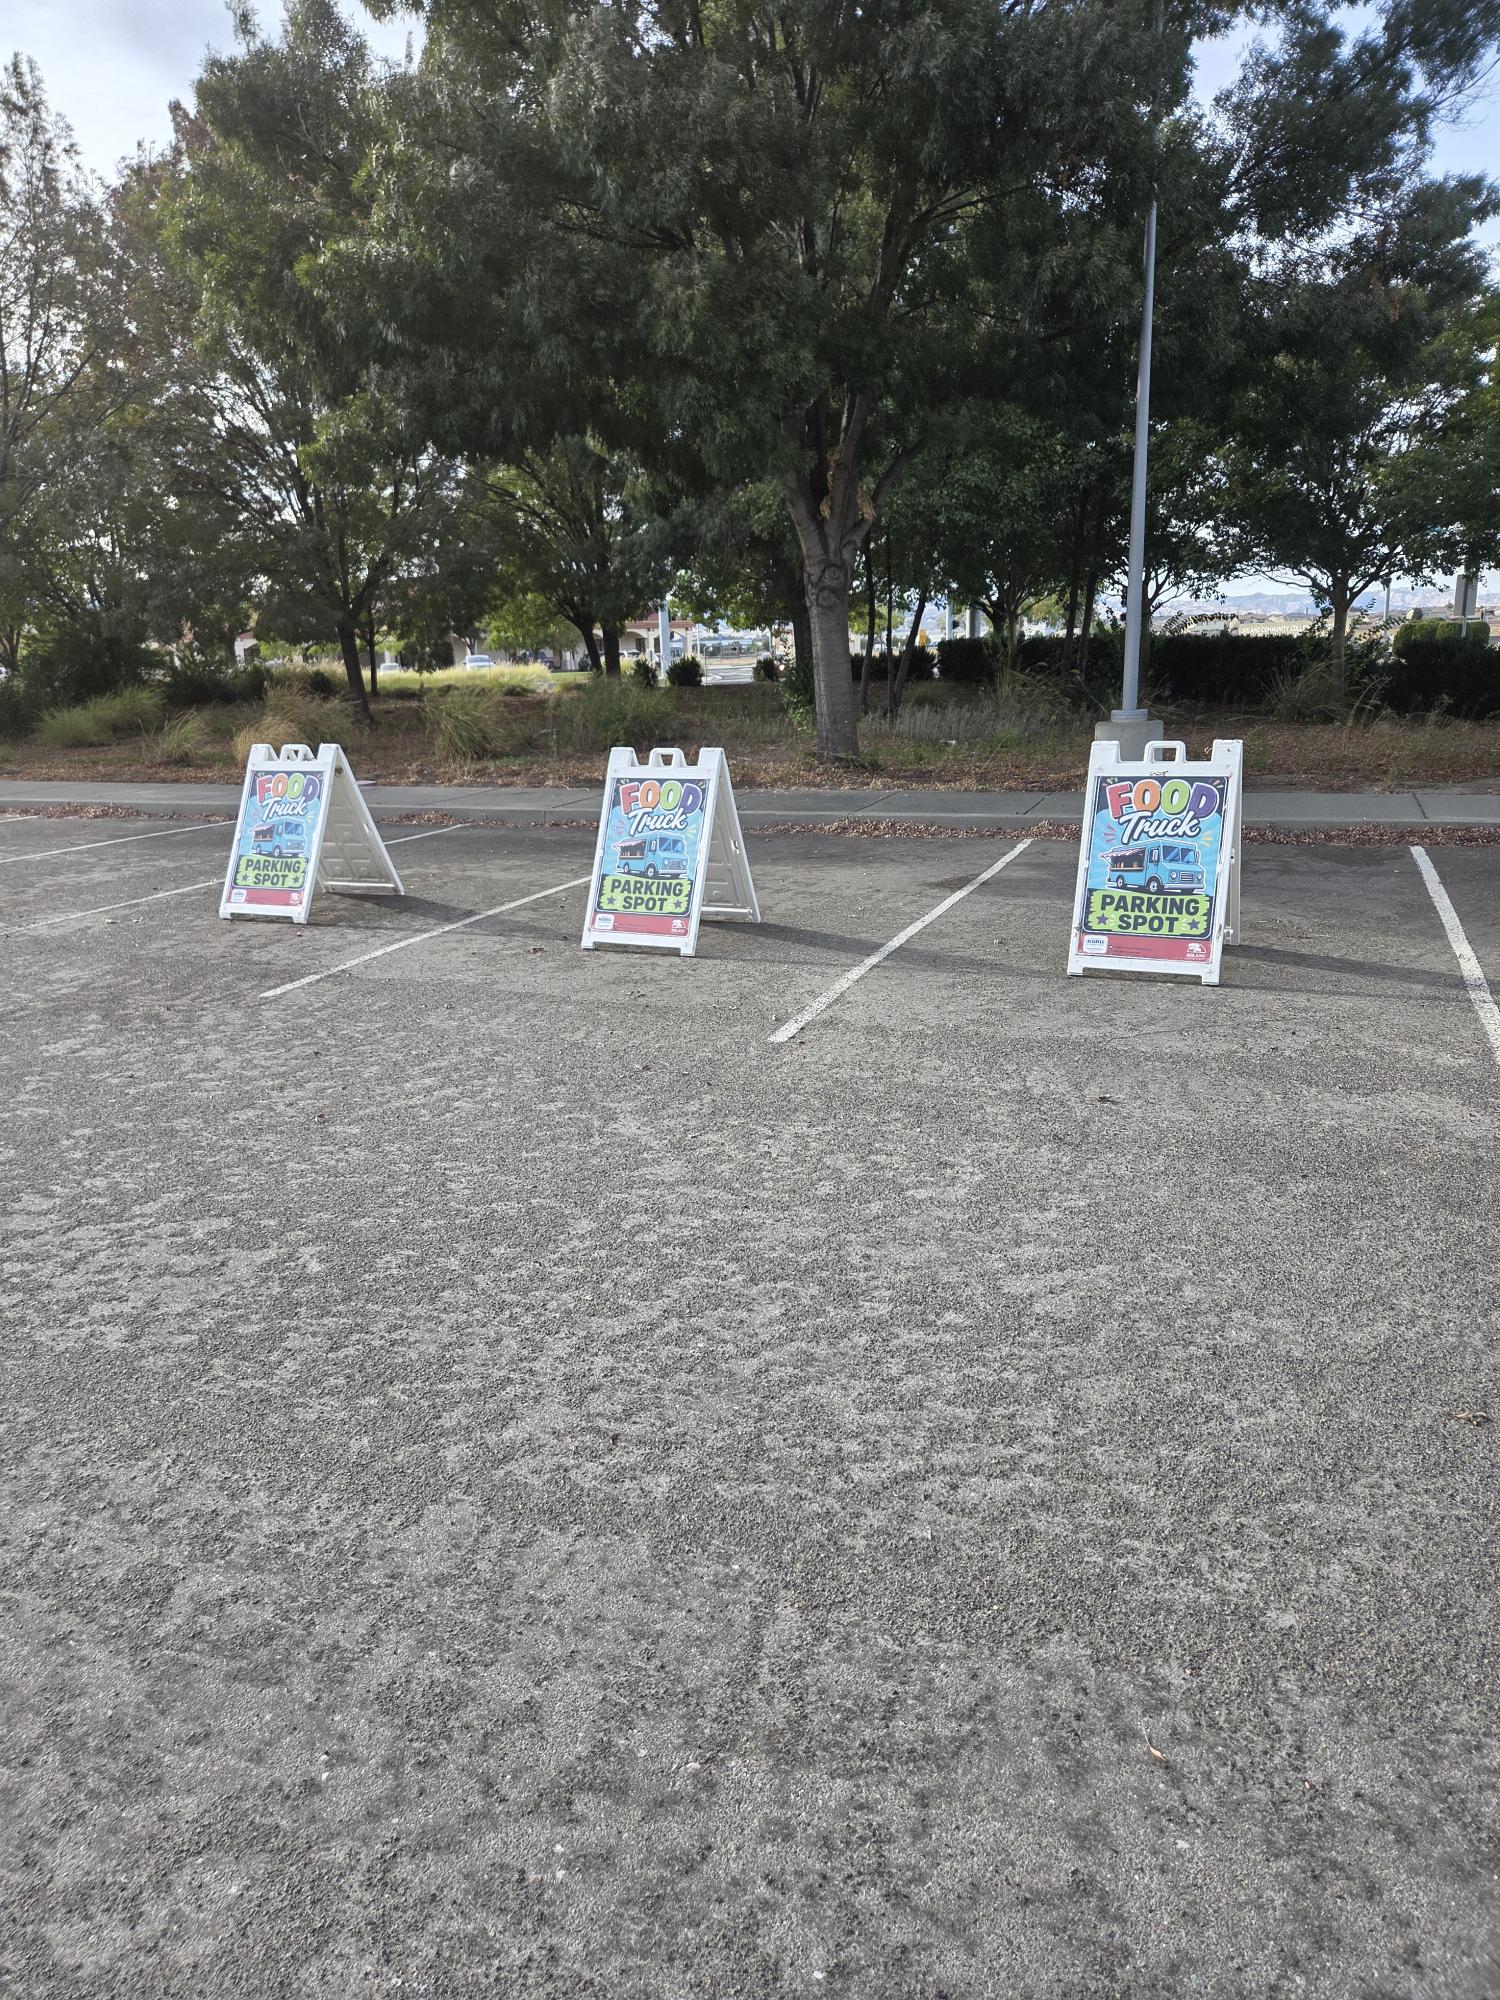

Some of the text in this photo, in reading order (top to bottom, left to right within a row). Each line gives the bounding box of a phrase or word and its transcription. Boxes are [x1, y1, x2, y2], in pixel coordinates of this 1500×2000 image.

[256, 773, 320, 803] FOOD
[620, 780, 702, 814] FOOD
[1106, 779, 1219, 819] FOOD
[263, 797, 308, 821] Truck
[629, 808, 687, 835] Truck
[1119, 811, 1200, 844] Truck
[245, 859, 301, 873] PARKING
[253, 873, 289, 886] SPOT
[611, 879, 684, 896] PARKING
[622, 896, 668, 911] SPOT
[1101, 894, 1200, 915] PARKING
[1117, 915, 1179, 933] SPOT
